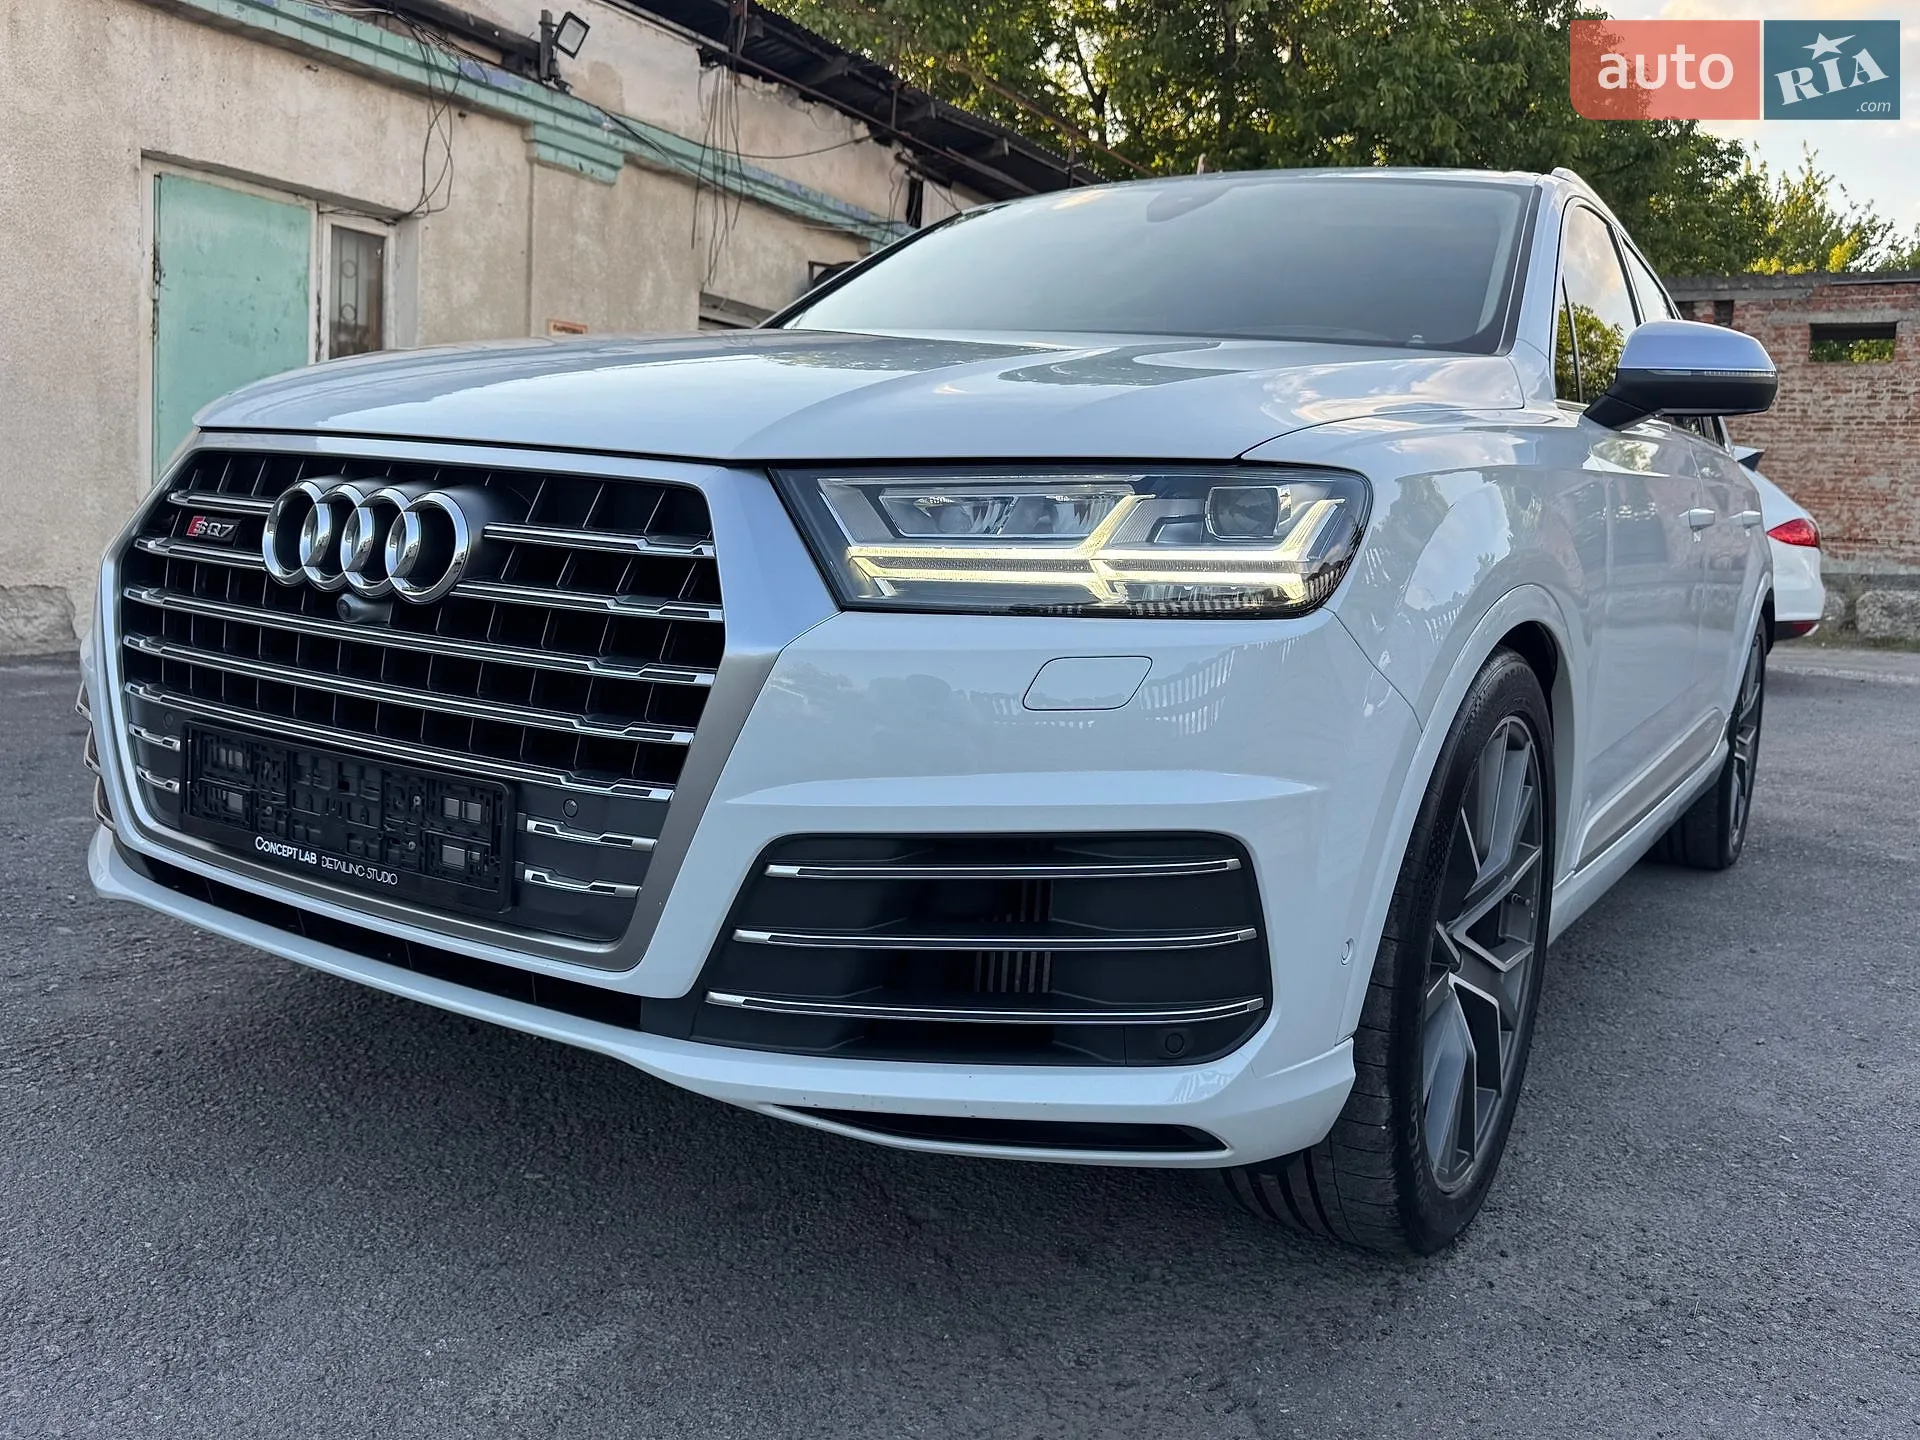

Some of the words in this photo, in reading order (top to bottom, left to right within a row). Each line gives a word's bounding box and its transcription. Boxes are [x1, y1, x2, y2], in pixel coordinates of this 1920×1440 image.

[193, 520, 235, 537] SQ7
[298, 848, 317, 865] LAB
[366, 867, 398, 885] STUDIO
